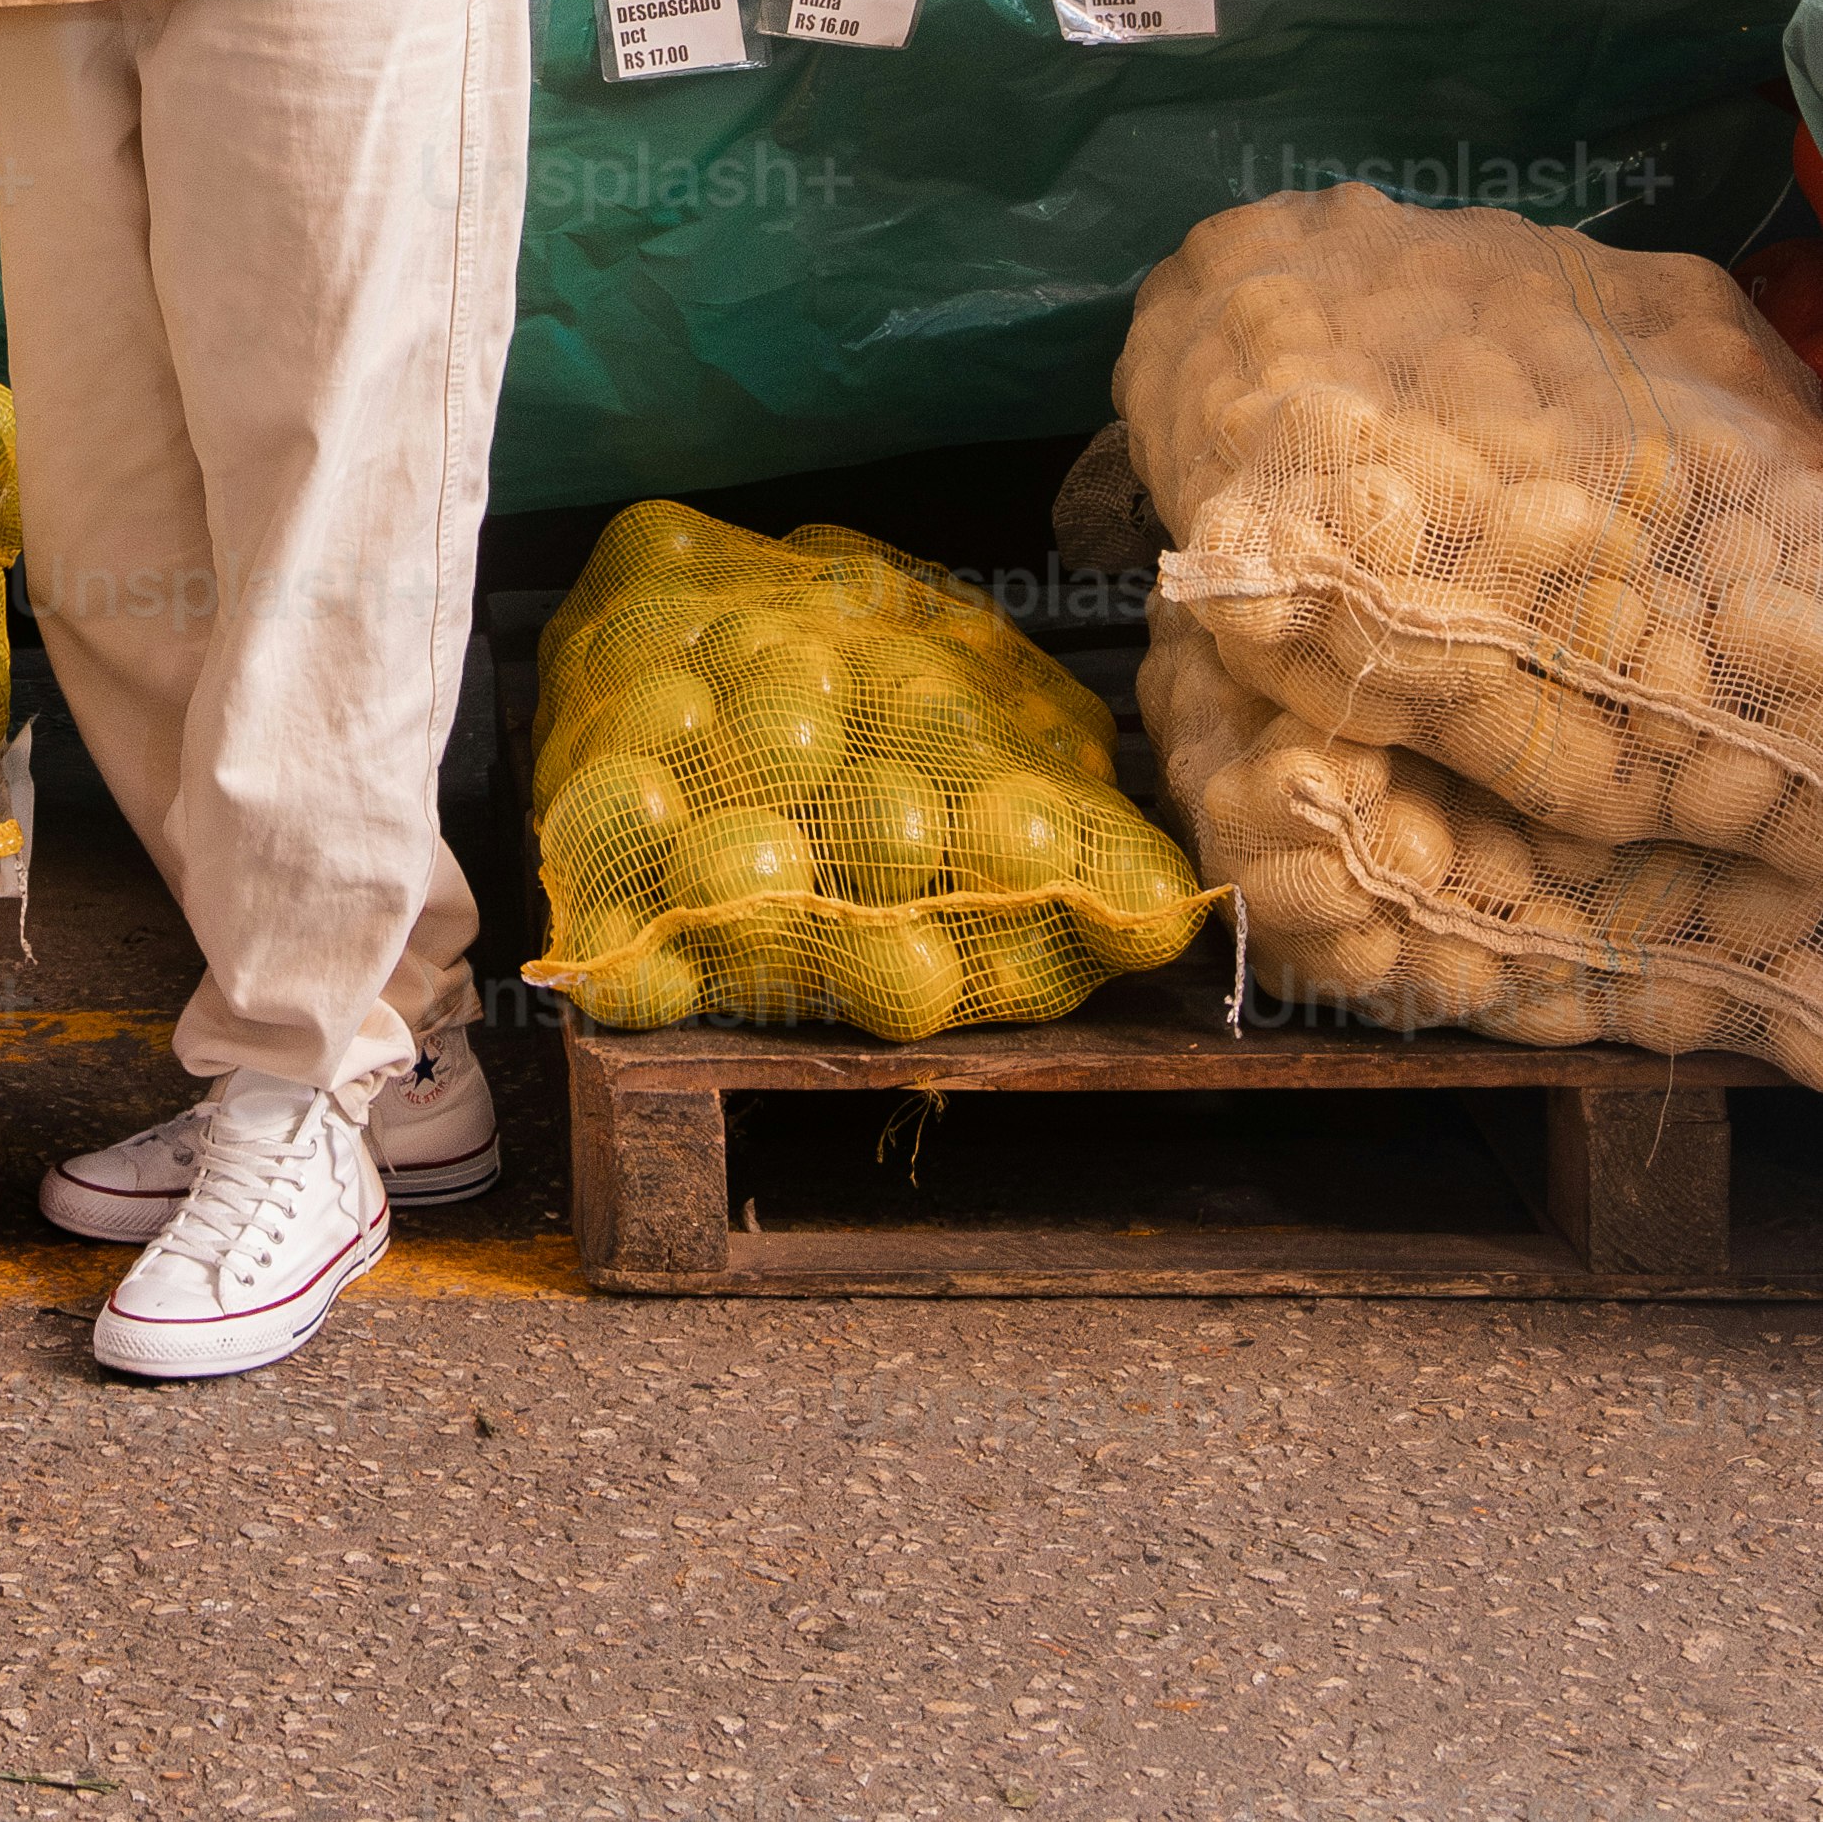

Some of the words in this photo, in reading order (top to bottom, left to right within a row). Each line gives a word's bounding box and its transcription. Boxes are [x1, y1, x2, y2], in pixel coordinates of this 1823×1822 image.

[795, 12, 816, 31] R$
[820, 16, 860, 36] 16,00
[1119, 11, 1162, 29] 10,00
[620, 26, 647, 47] pct
[623, 51, 645, 70] R$
[648, 45, 689, 66] 17,00
[405, 1090, 421, 1104] ALL
